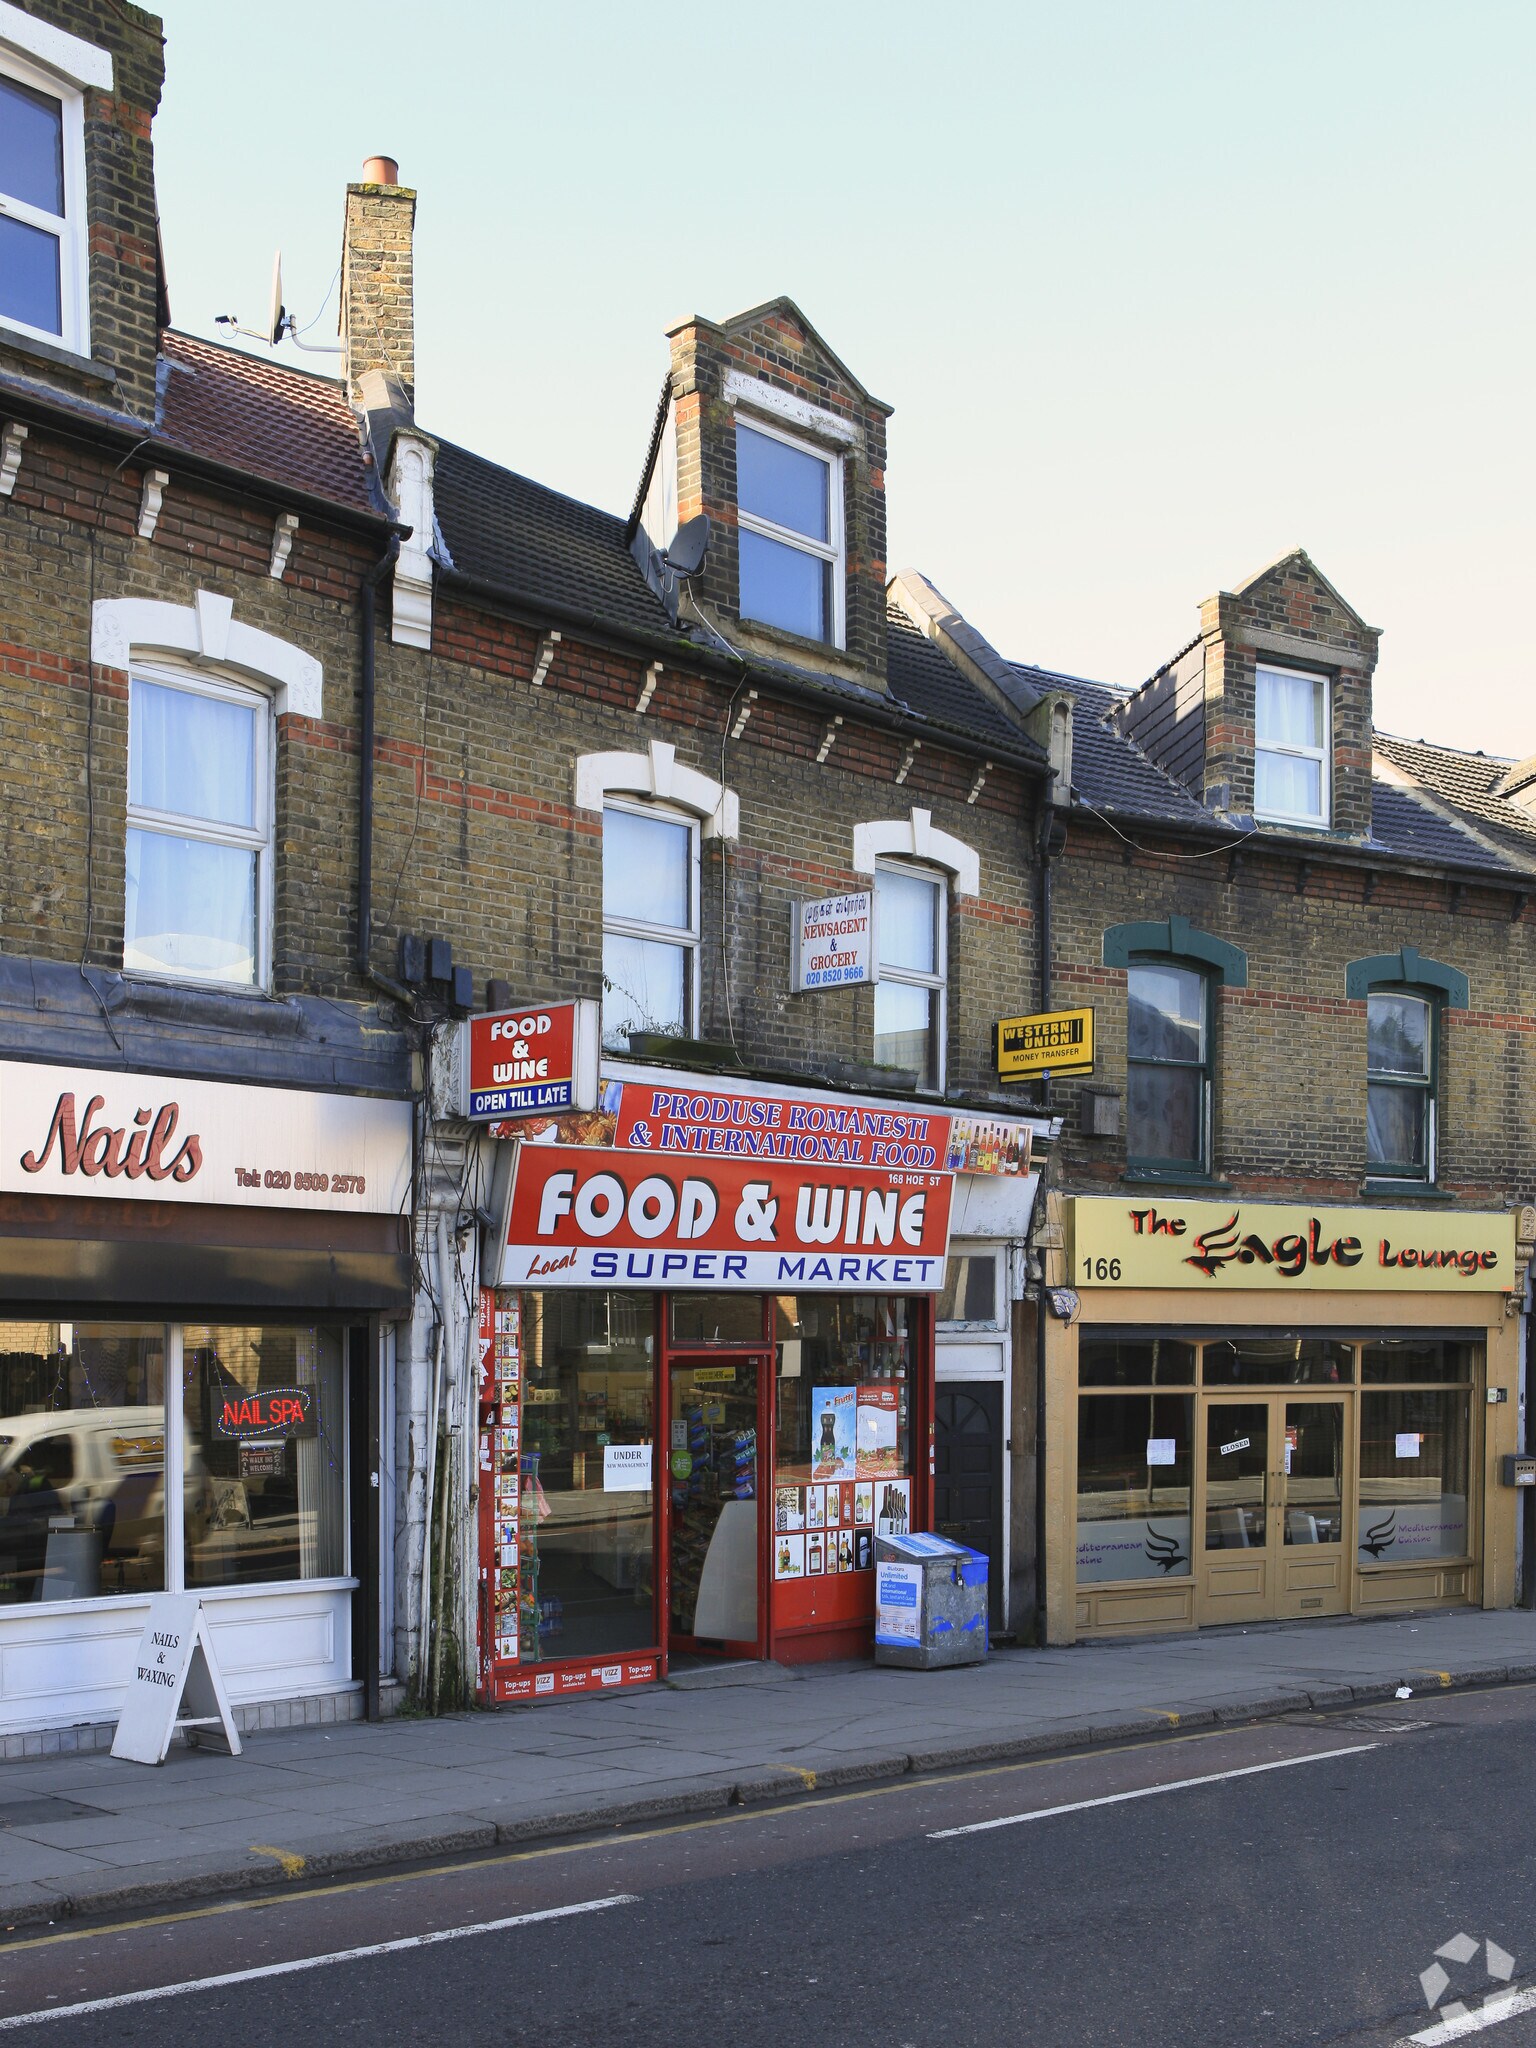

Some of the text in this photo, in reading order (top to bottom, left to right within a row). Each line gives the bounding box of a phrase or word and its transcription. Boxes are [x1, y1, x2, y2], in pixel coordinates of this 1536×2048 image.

[804, 917, 867, 940] NEWSAGENT
[829, 938, 838, 952] &
[810, 951, 858, 971] GROCERY
[806, 966, 864, 985] 020 8520 9666
[490, 1014, 552, 1041] FOOD
[1004, 1020, 1070, 1040] WESTERN
[512, 1040, 529, 1059] &
[1024, 1032, 1070, 1049] UNION
[1012, 1048, 1080, 1062] MONEY TRANSFER
[493, 1058, 548, 1083] WINE
[475, 1085, 568, 1112] OPEN TILL LATE
[650, 1091, 783, 1128] PRODUSE
[20, 1091, 203, 1183] Nails
[628, 1121, 653, 1147] &
[660, 1123, 863, 1163] INTERNATIONAL
[869, 1141, 937, 1168] FOOD
[235, 1168, 366, 1195] Tel: 020 8509 2578
[888, 1173, 941, 1186] 168 HOE ST
[537, 1170, 928, 1247] FOOD & WINE
[1129, 1208, 1188, 1236] The
[1379, 1238, 1499, 1277] Lounge
[526, 1247, 936, 1282] Local SUPER MARKET
[1082, 1257, 1122, 1281] 166
[224, 1399, 305, 1425] NAIL SPA
[613, 1450, 642, 1460] UNDER
[1221, 1439, 1249, 1453] CLOSED
[249, 1464, 274, 1473] WELCOME
[1398, 1522, 1464, 1533] Mediterranean
[1398, 1535, 1432, 1544] Cuisine
[880, 1571, 909, 1580] Unlimited
[151, 1631, 180, 1649] NAILS
[156, 1651, 166, 1664] &
[137, 1666, 176, 1688] WAXING
[561, 1673, 587, 1682] Top-ups
[628, 1664, 653, 1674] Top-ups
[504, 1680, 531, 1689] Top-ups
